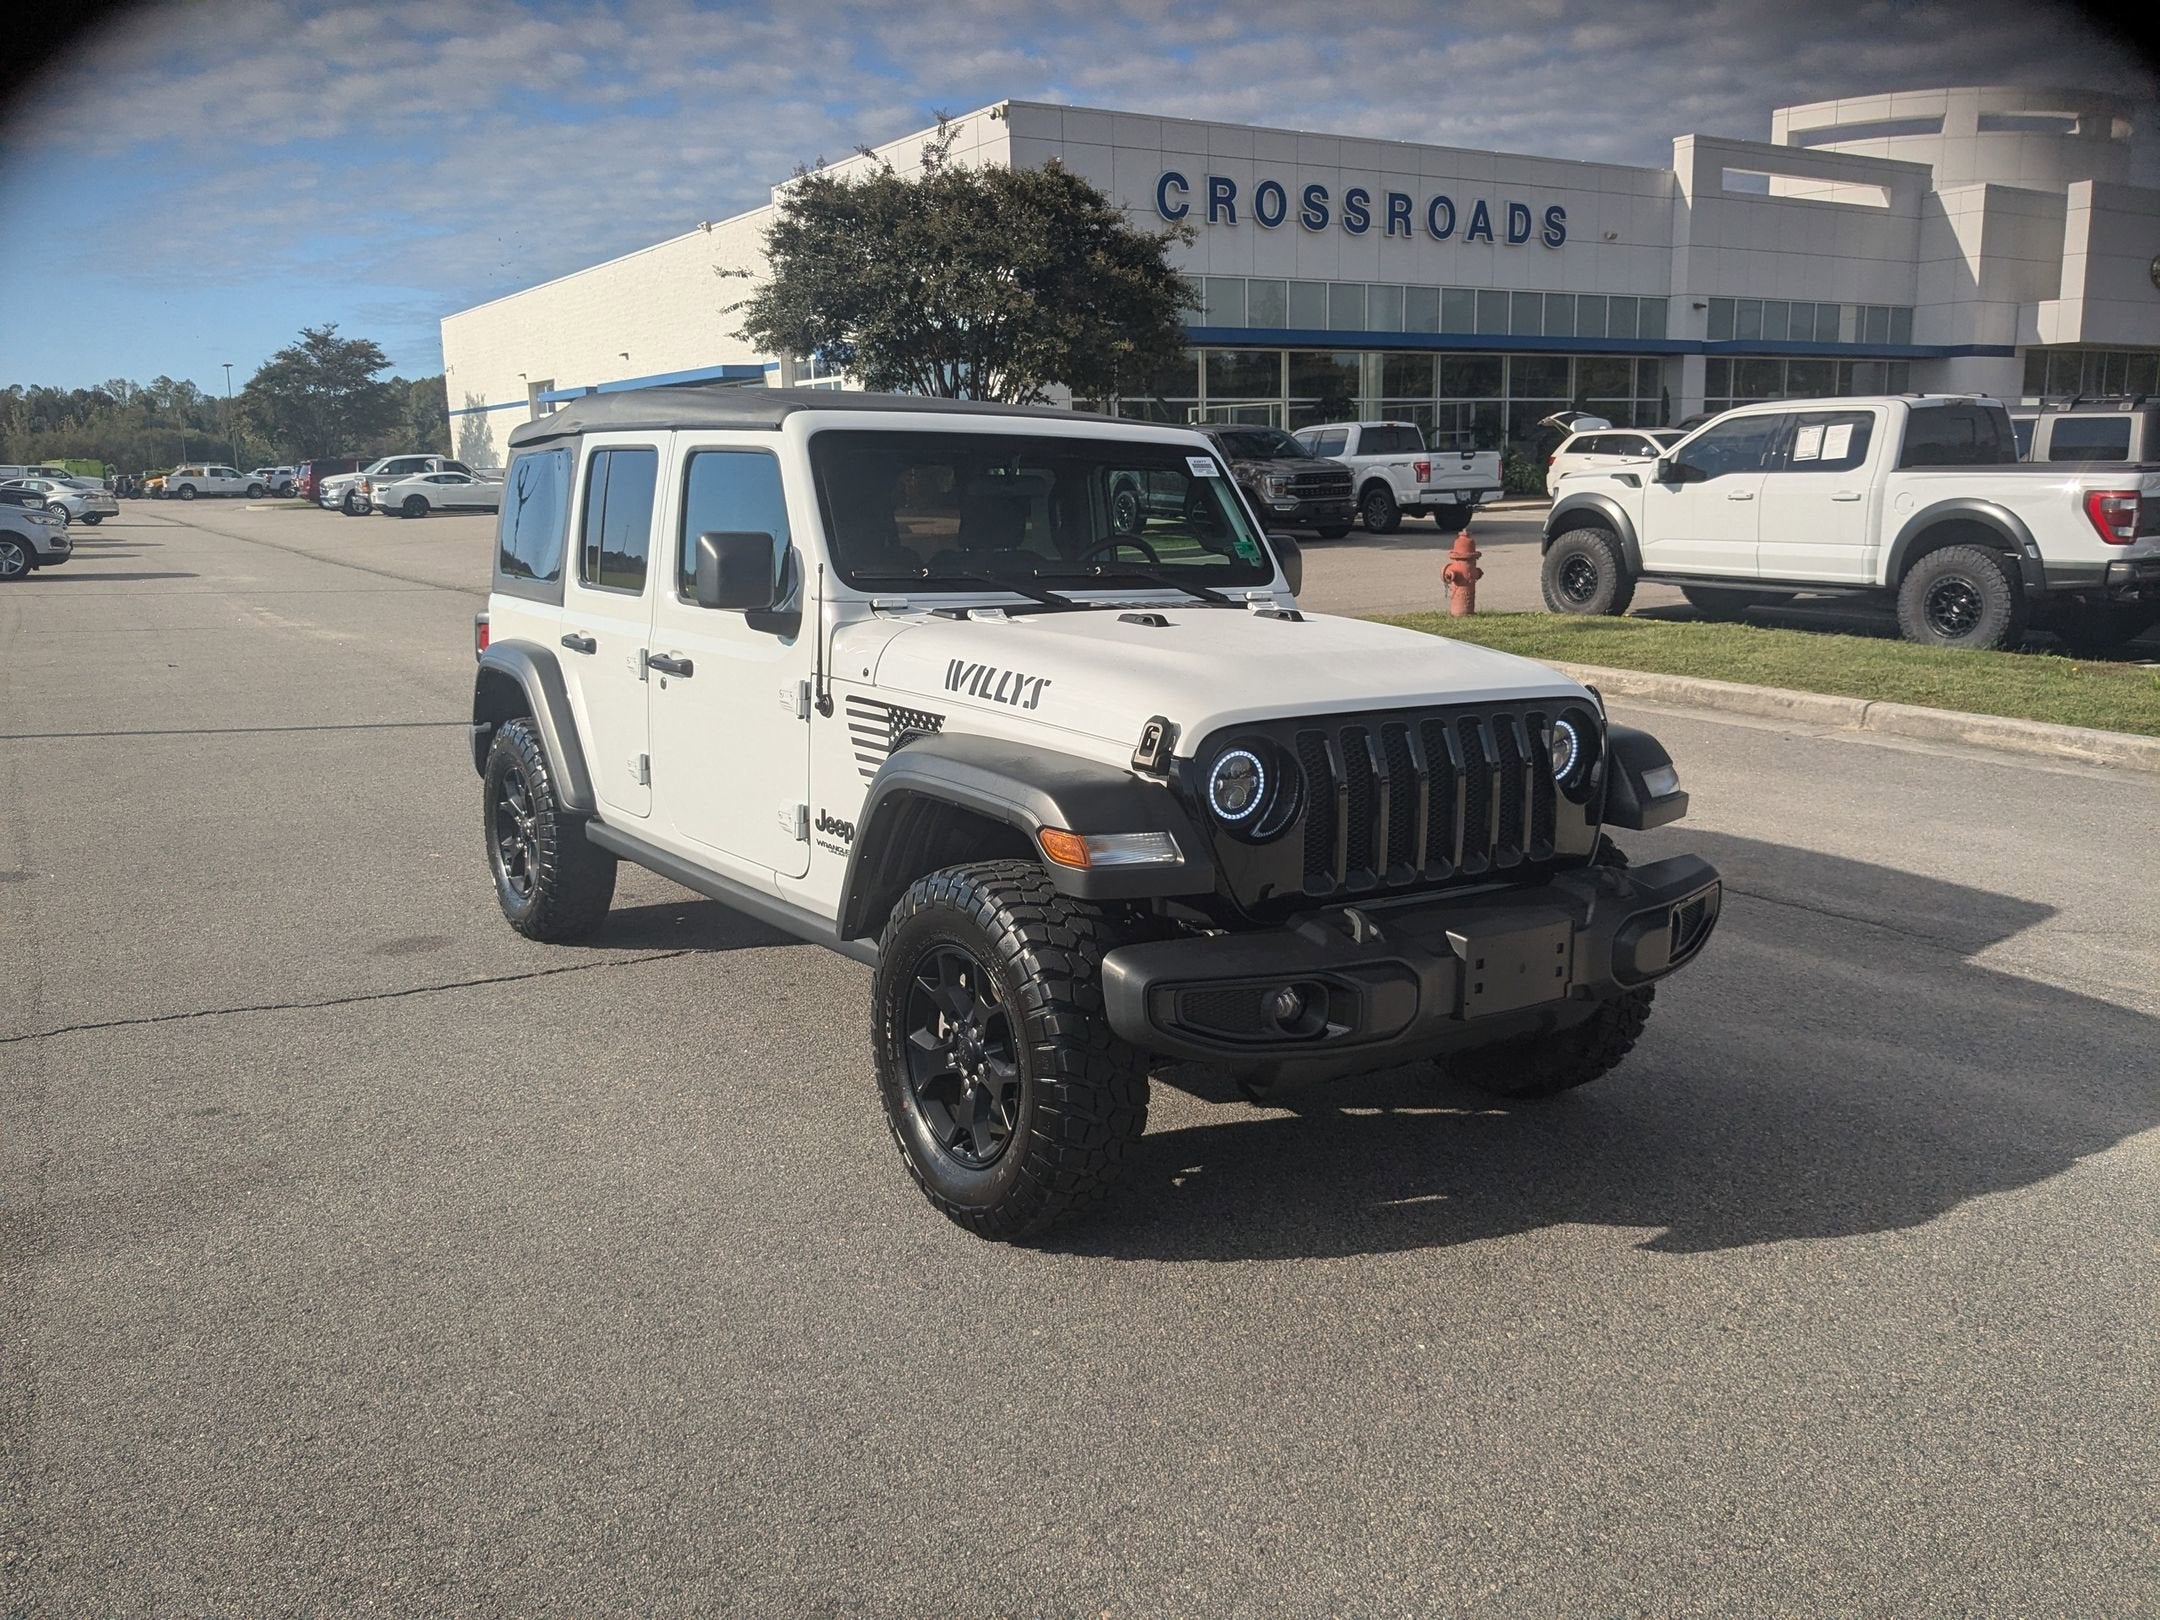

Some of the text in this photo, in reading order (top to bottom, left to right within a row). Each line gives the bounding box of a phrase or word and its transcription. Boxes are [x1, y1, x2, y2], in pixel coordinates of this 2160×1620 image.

[1154, 170, 1568, 249] CROSSROADS
[945, 659, 1051, 710] WILLYS
[814, 807, 855, 845] Jeep
[815, 838, 851, 855] WRANGLE
